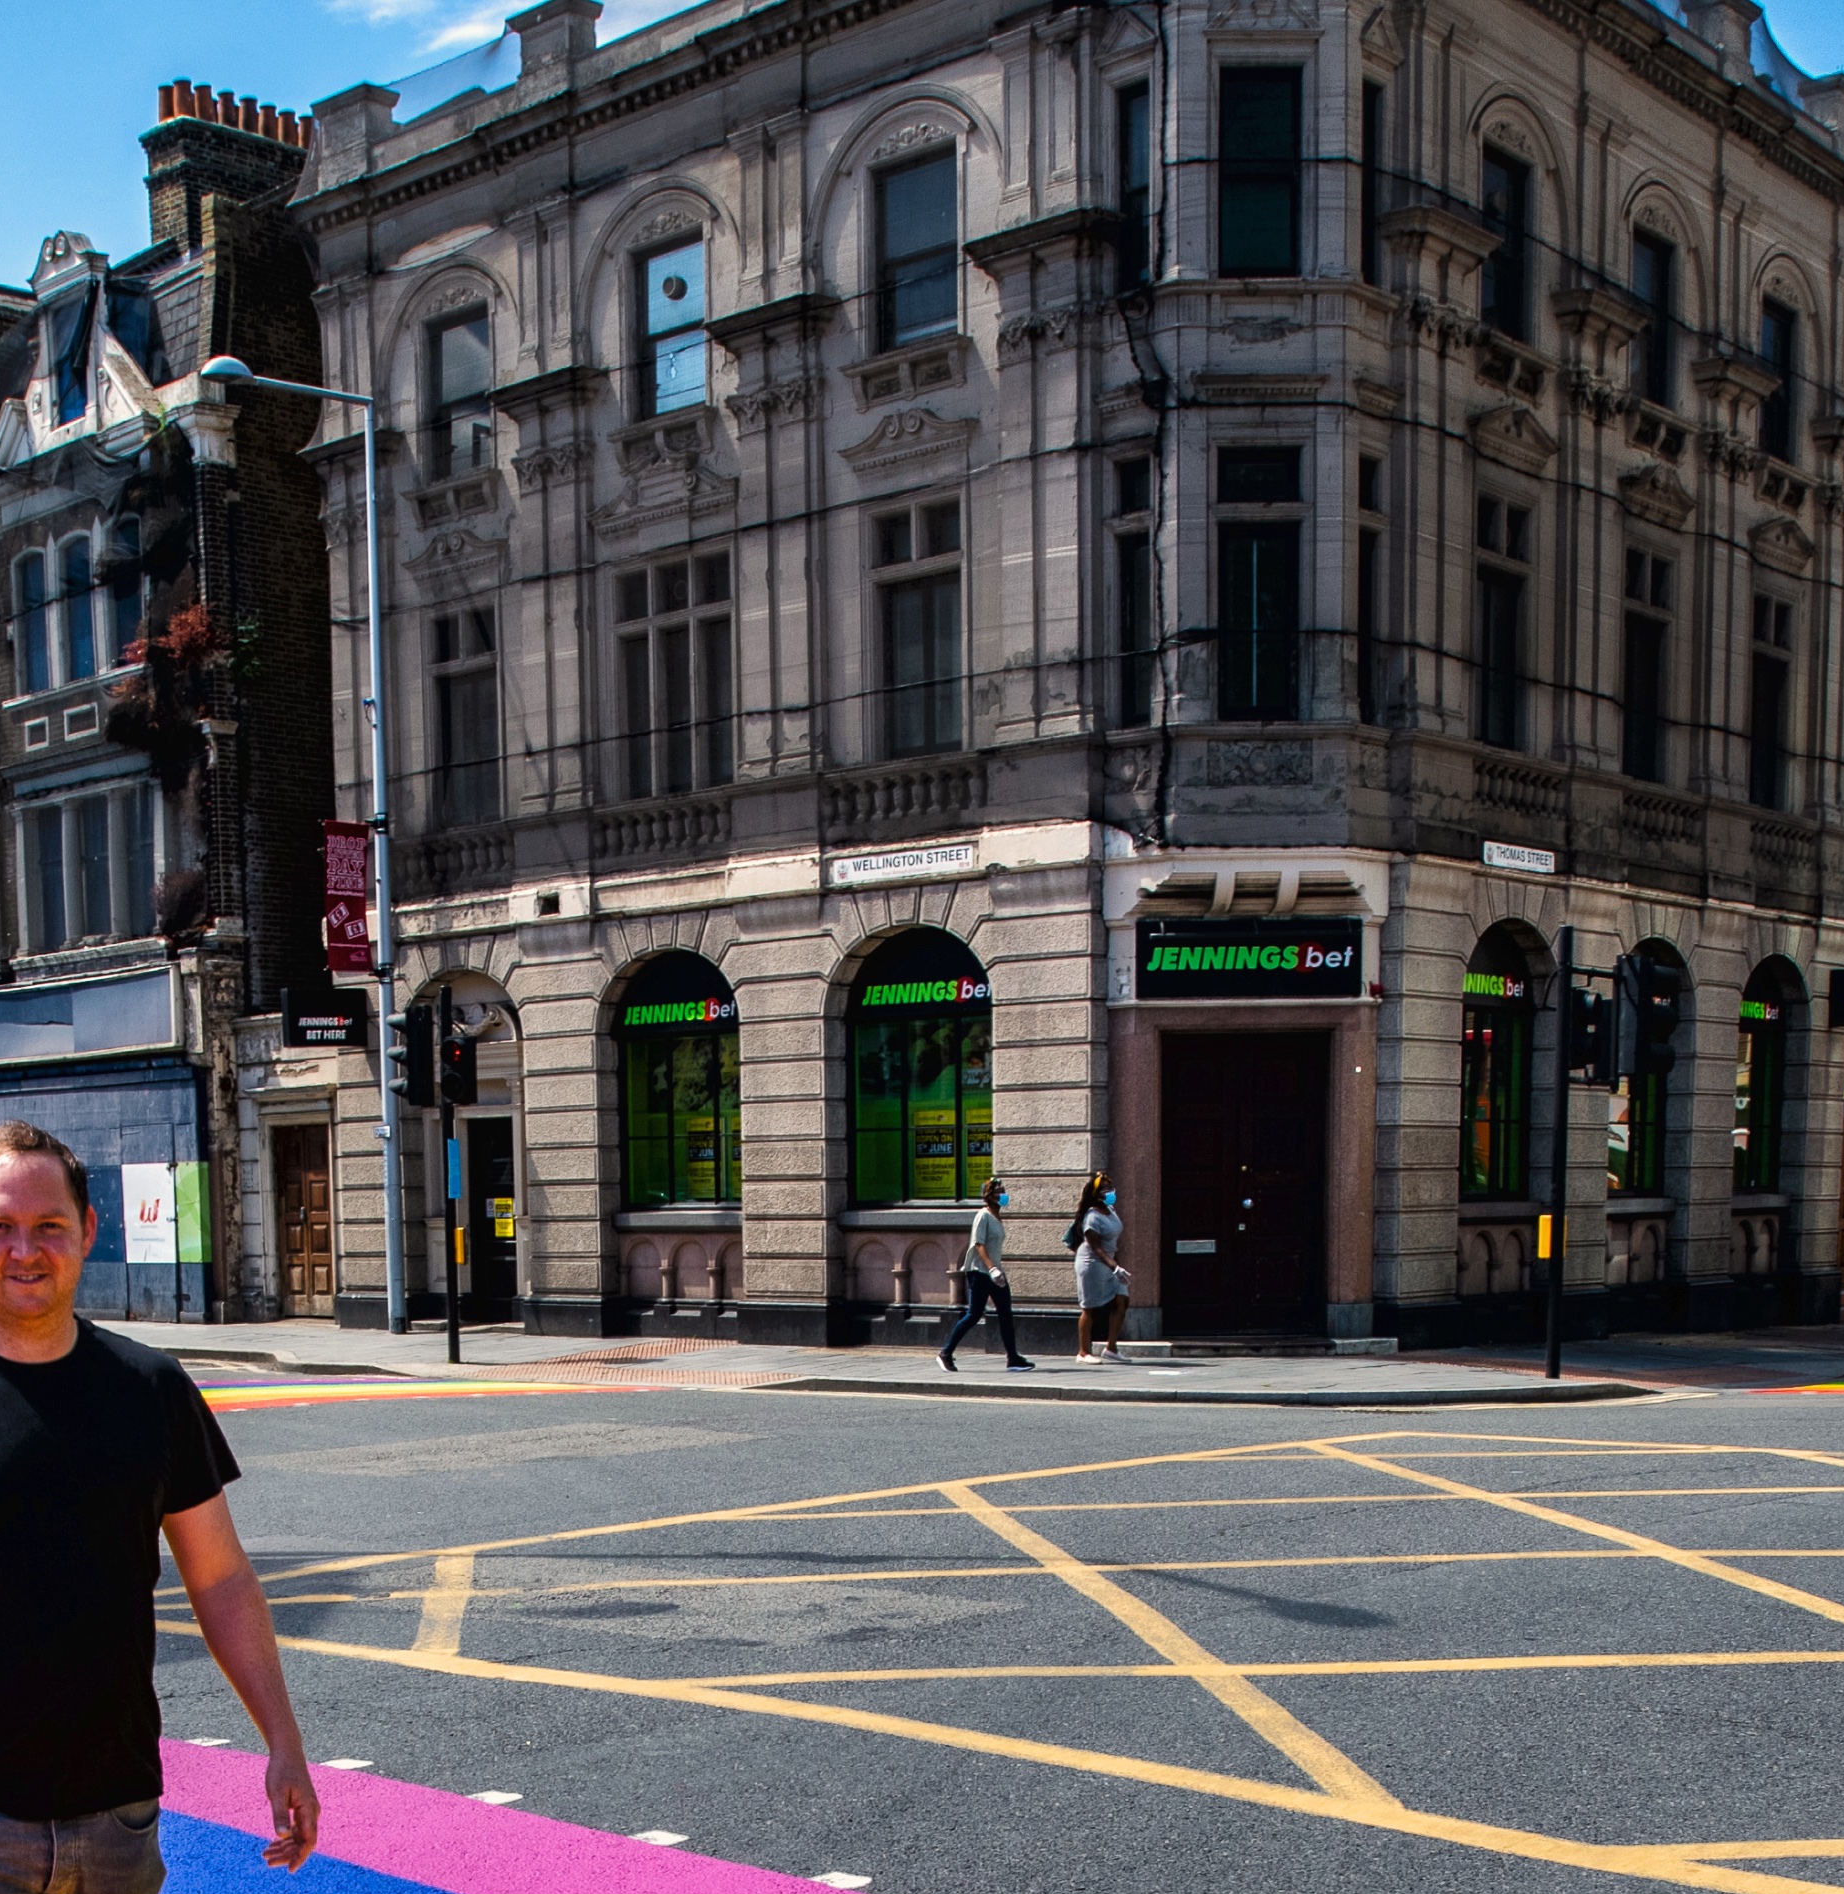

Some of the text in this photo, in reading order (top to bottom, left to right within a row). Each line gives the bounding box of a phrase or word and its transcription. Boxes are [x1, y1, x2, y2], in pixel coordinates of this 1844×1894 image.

[326, 834, 367, 851] DROP
[852, 847, 970, 872] WELLINGTON STREET
[1496, 845, 1526, 863] THOMAS
[1527, 850, 1553, 867] STREET
[326, 858, 365, 877] PAY
[326, 874, 365, 890] FINE
[1147, 945, 1354, 971] JENNINGS bet
[861, 980, 958, 1006] JENNINGS
[298, 1017, 339, 1027] JENNINGS
[623, 1002, 706, 1026] JENNINGS
[306, 1029, 347, 1040] BET HERE
